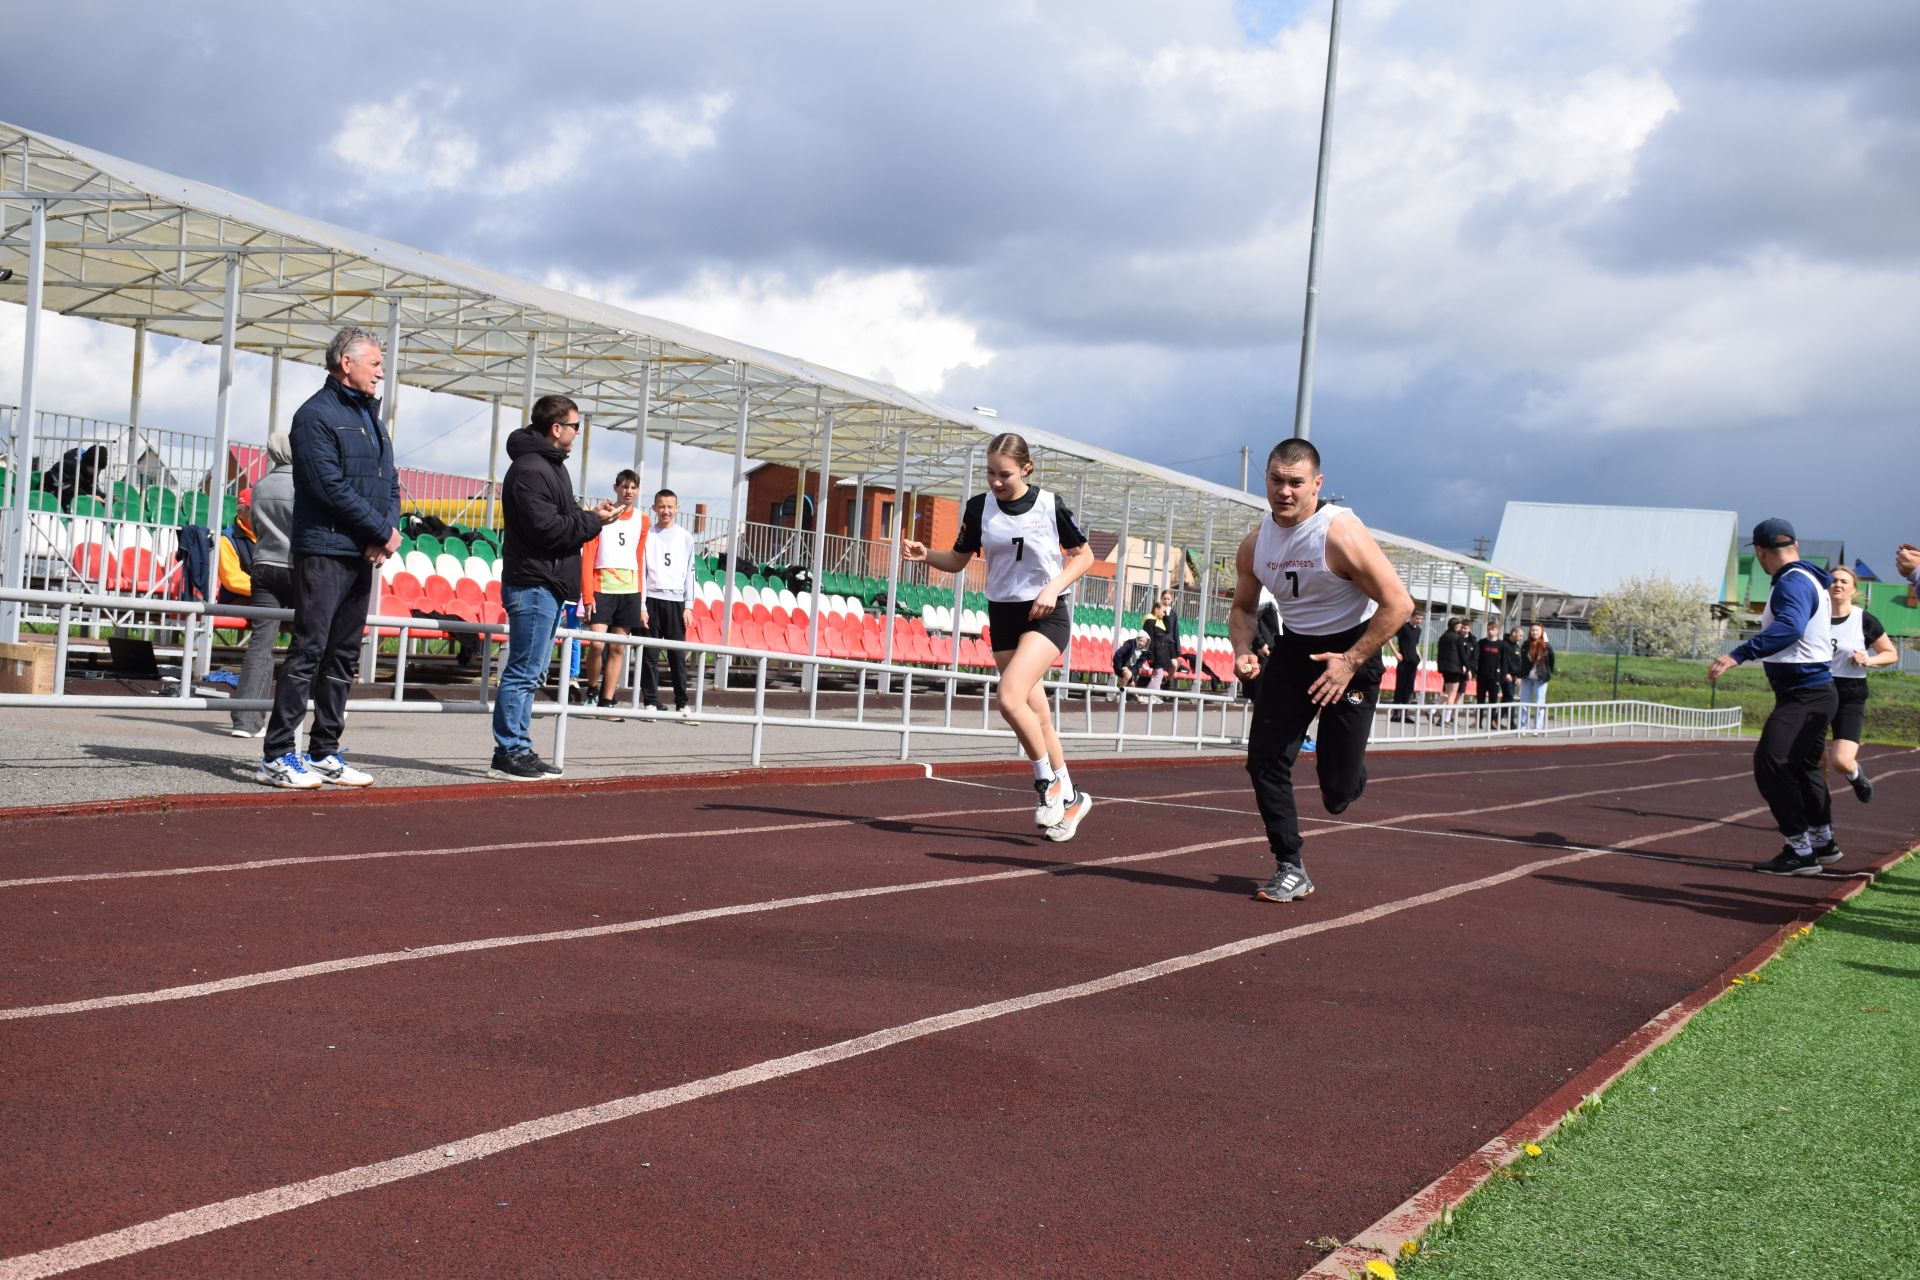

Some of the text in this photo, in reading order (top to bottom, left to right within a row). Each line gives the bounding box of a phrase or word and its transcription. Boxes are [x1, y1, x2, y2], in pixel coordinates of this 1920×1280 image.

[618, 532, 626, 546] 5
[1011, 536, 1025, 562] 7
[664, 552, 671, 567] 5
[1284, 571, 1299, 598] 7
